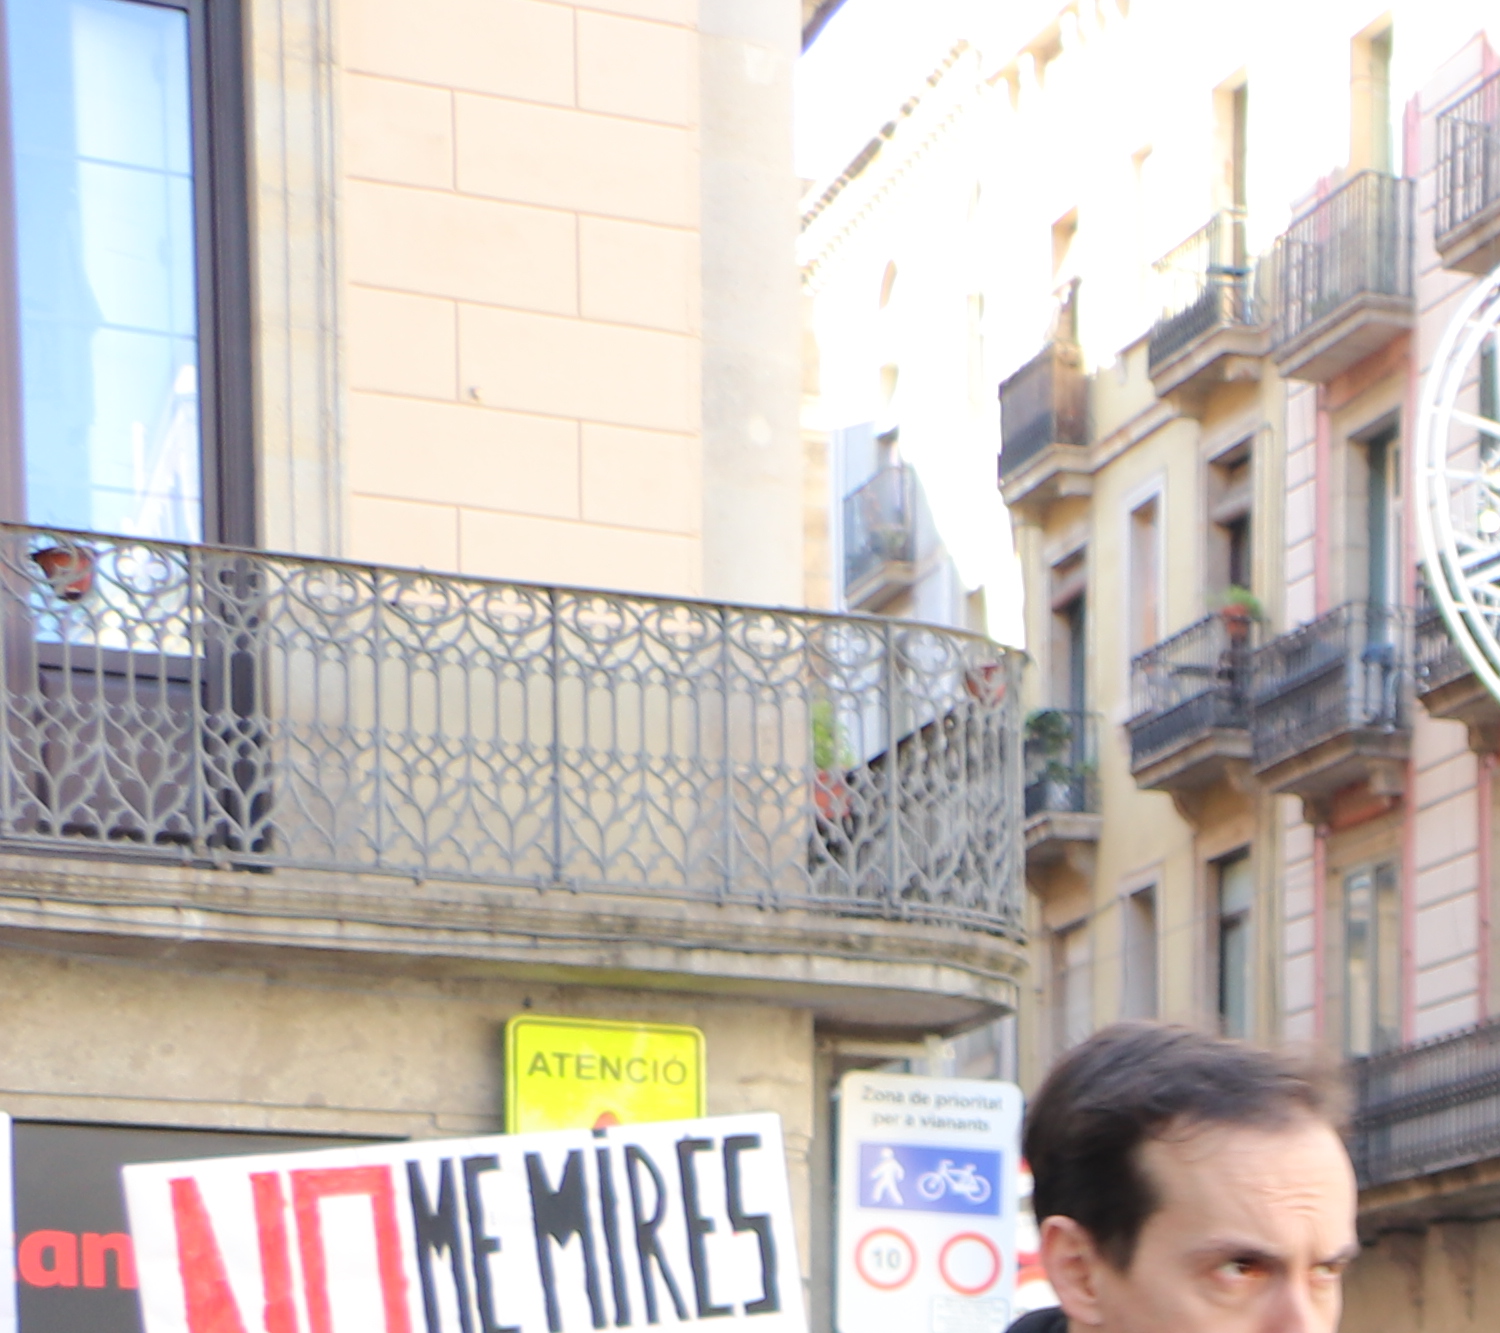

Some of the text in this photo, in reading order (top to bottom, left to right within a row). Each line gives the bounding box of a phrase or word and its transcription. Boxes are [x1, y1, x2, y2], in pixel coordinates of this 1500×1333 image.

[527, 1051, 688, 1087] ATENCIÓ
[862, 1085, 1004, 1112] Zona de prioritat
[921, 1113, 992, 1132] vianants
[15, 1229, 139, 1290] an
[873, 1249, 901, 1270] 10
